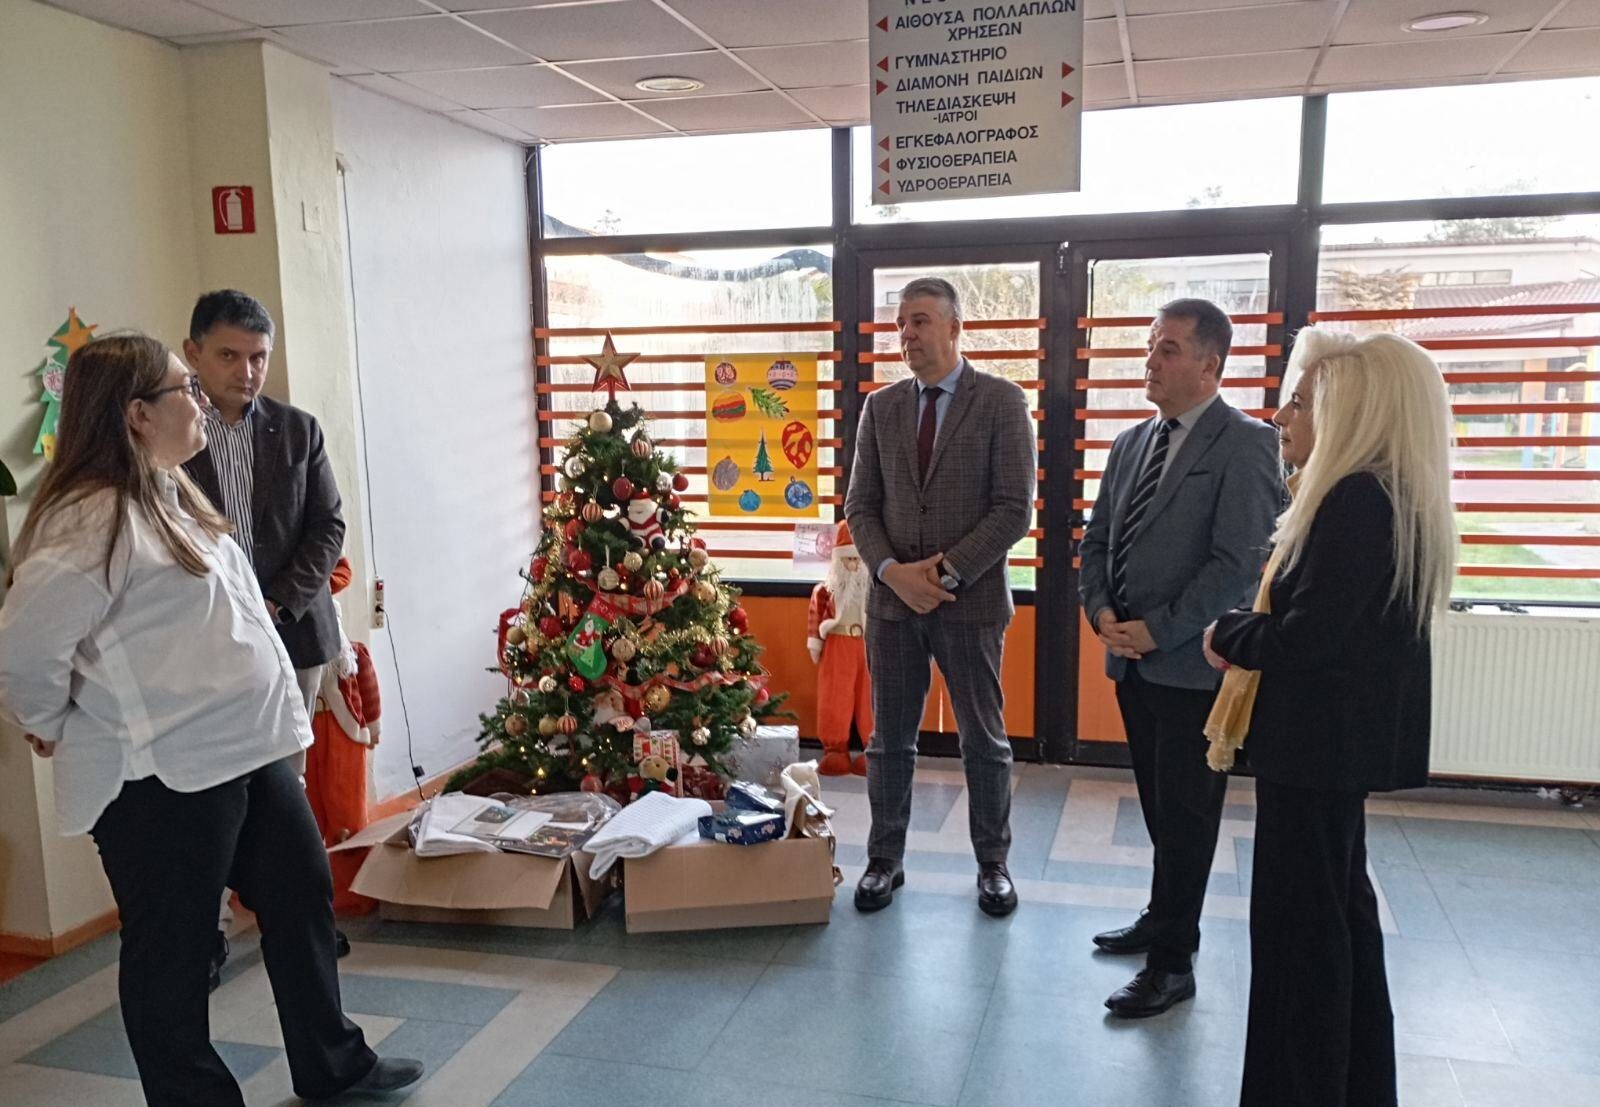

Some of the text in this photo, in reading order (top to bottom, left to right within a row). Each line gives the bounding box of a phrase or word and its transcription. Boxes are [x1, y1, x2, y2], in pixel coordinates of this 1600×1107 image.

[895, 0, 1076, 30] ΑΙΘΟΥΣΑ ΠΟΛΛΑΠΛΩΝ
[948, 22, 1022, 41] ΧΡΗΣΕΩΝ
[895, 46, 1007, 69] ΓΥΜΝΑΣΤΗΡΙΟ
[896, 66, 1043, 91] ΔΙΑΜΟΝΗ ΠΑΙΔΙΩΝ
[896, 91, 1016, 114] ΤΗΛΕΔΙΑΣΚΕΨΗ
[933, 110, 977, 124] -ΙΑΤΡΟΙ
[896, 125, 1039, 149] ΕΓΚΕΦΑΛΟΓΡΑΦΟΣ
[896, 150, 1017, 171] ΦΥΣΙΟΘΕΡΑΠΕΙΑ
[897, 172, 1012, 193] ΥΔΡΟΘΕΡΑΠΕΙΑ
